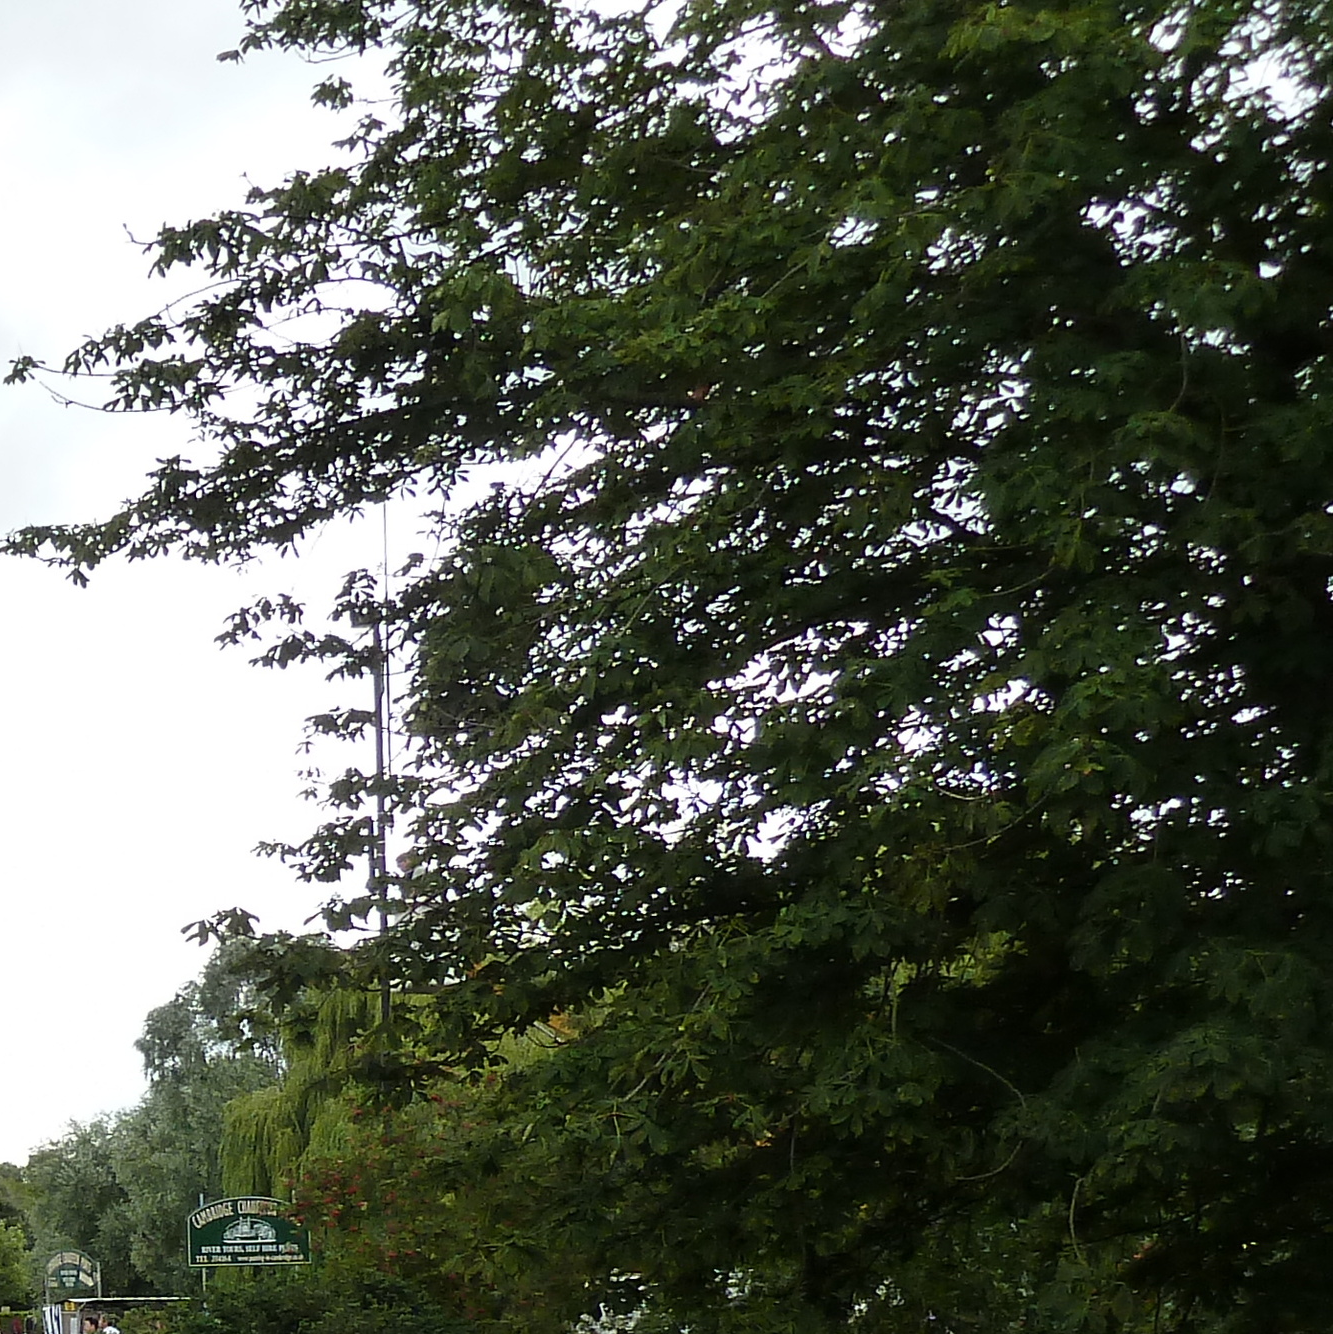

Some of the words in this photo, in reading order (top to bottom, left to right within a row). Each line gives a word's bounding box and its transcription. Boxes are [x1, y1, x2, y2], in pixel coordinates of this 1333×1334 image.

[191, 1201, 234, 1229] CAMBRIDGE
[201, 1246, 221, 1254] RIVER
[245, 1244, 261, 1253] SELF
